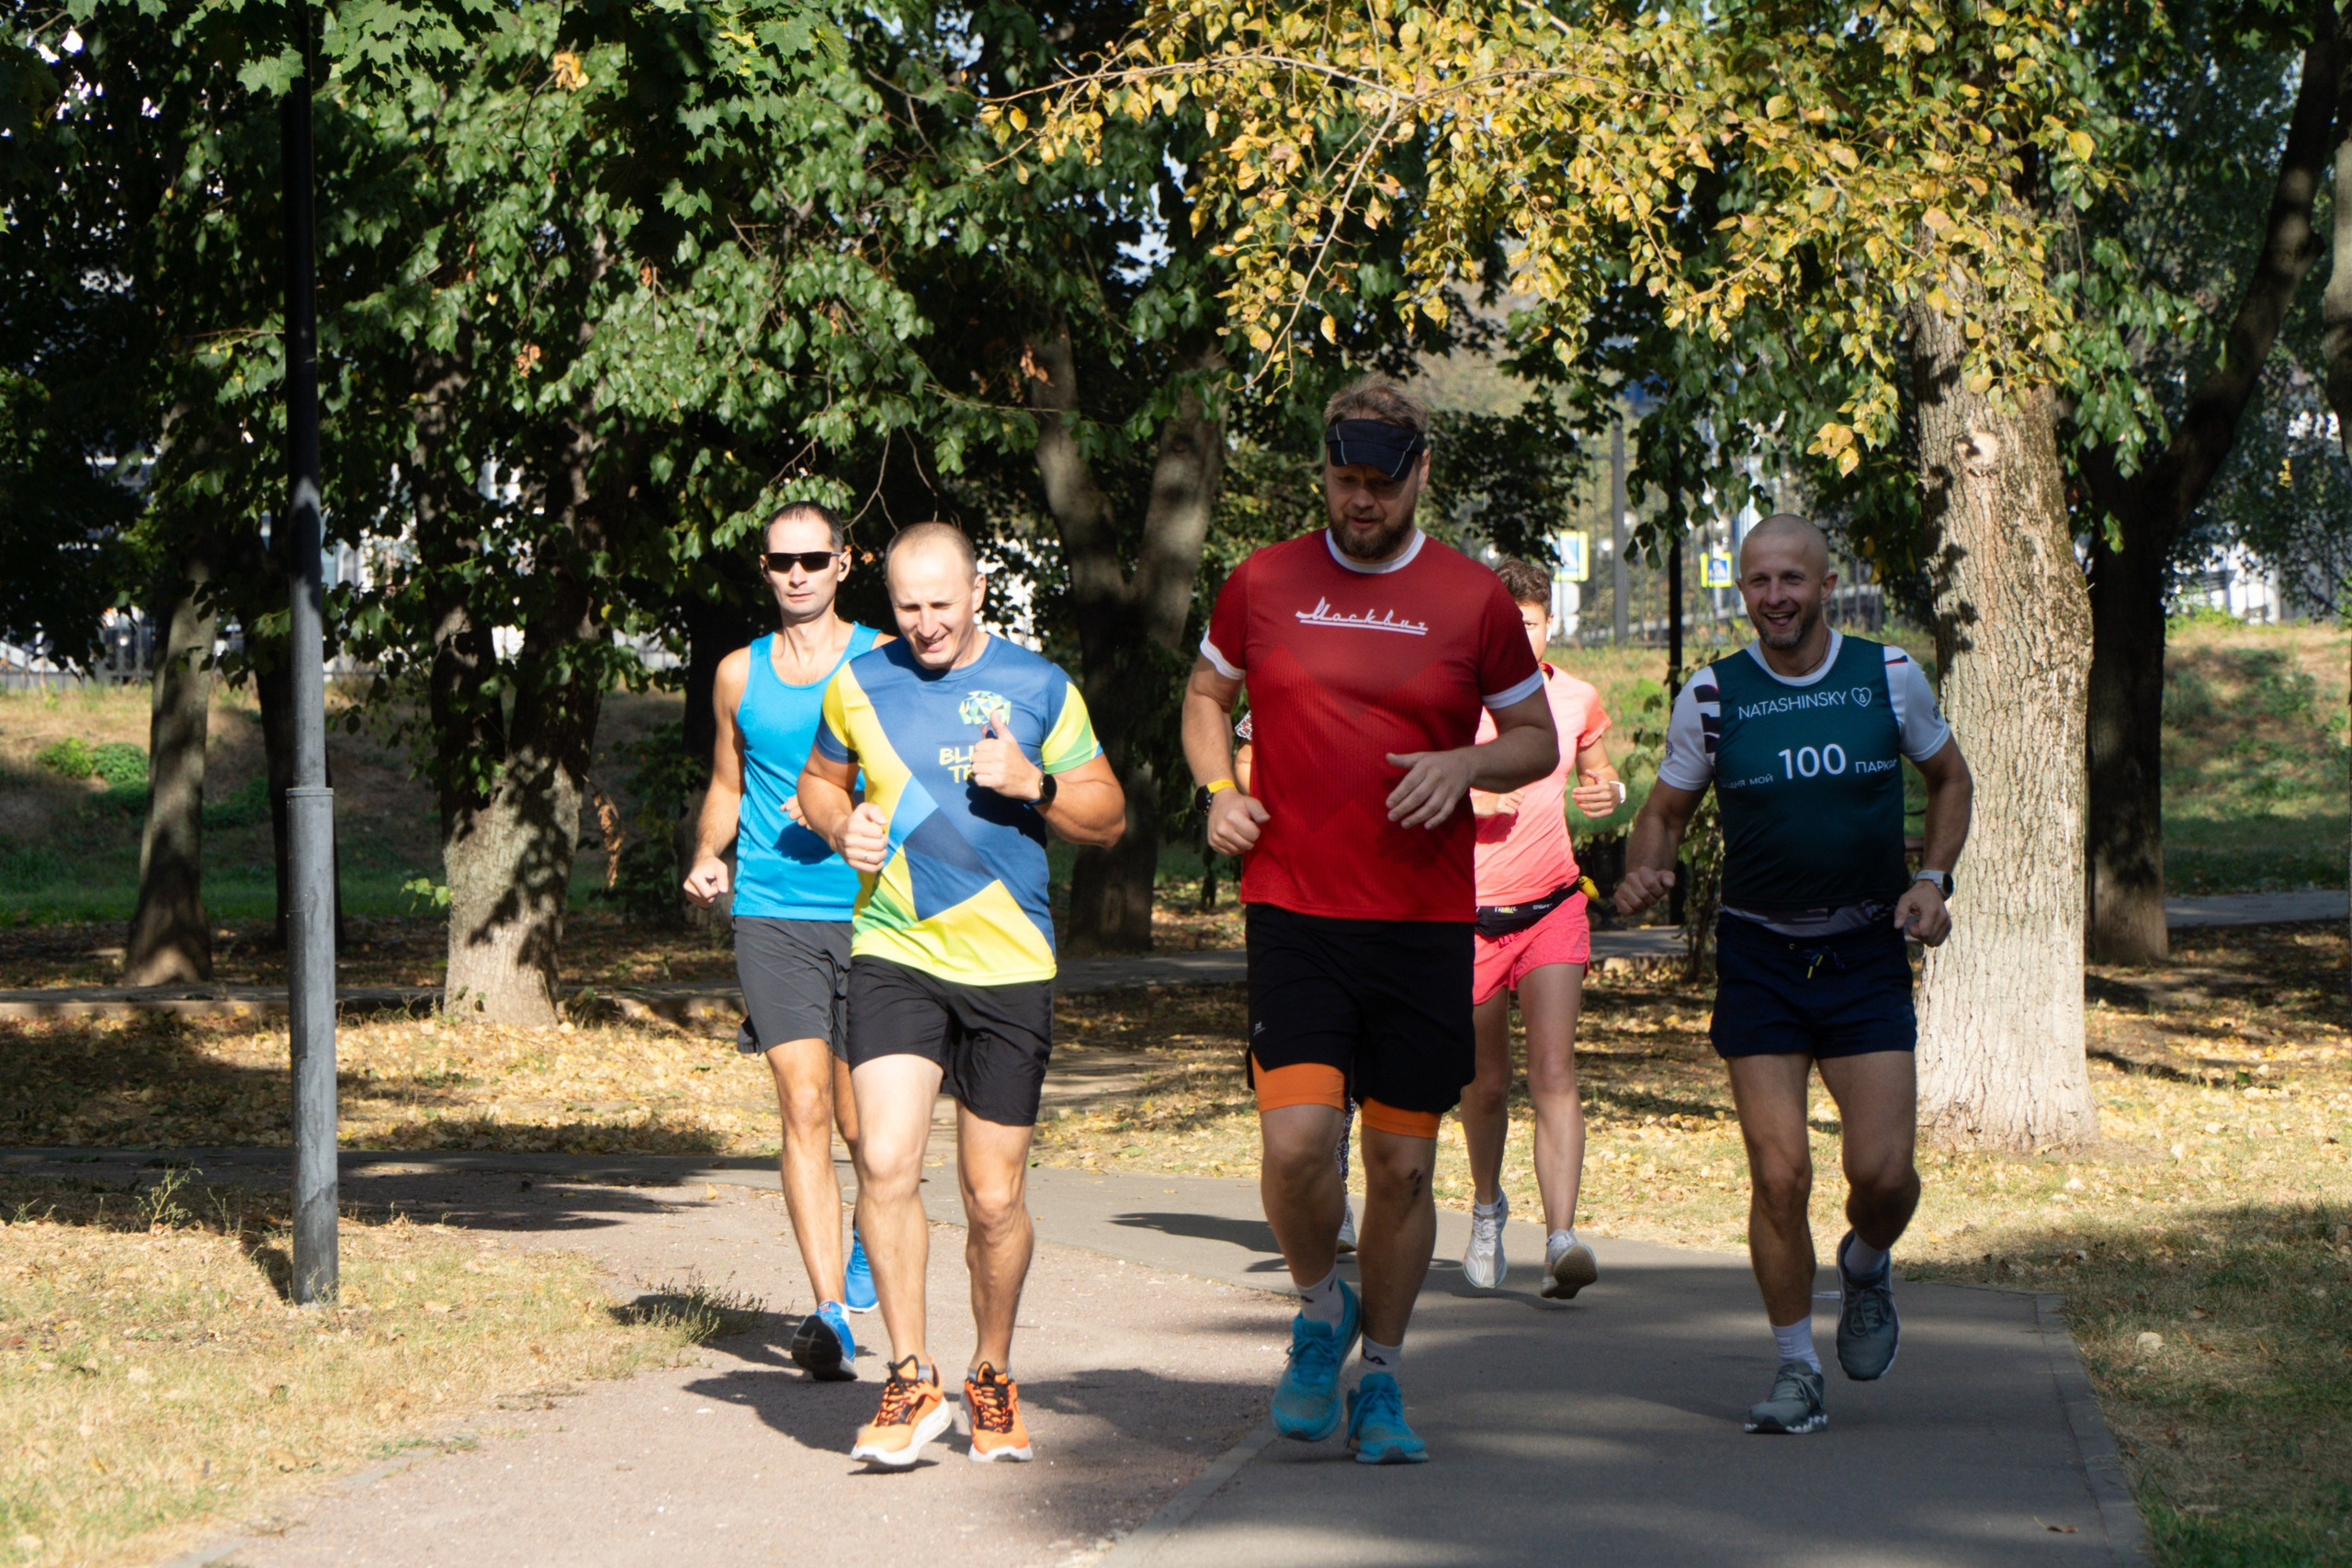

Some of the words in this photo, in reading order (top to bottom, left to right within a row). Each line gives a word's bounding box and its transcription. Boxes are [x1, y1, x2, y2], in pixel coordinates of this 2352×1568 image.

[1738, 691, 1847, 719] NATASHINSKY
[1749, 773, 1774, 785] МОЙ
[1778, 743, 1847, 780] 100
